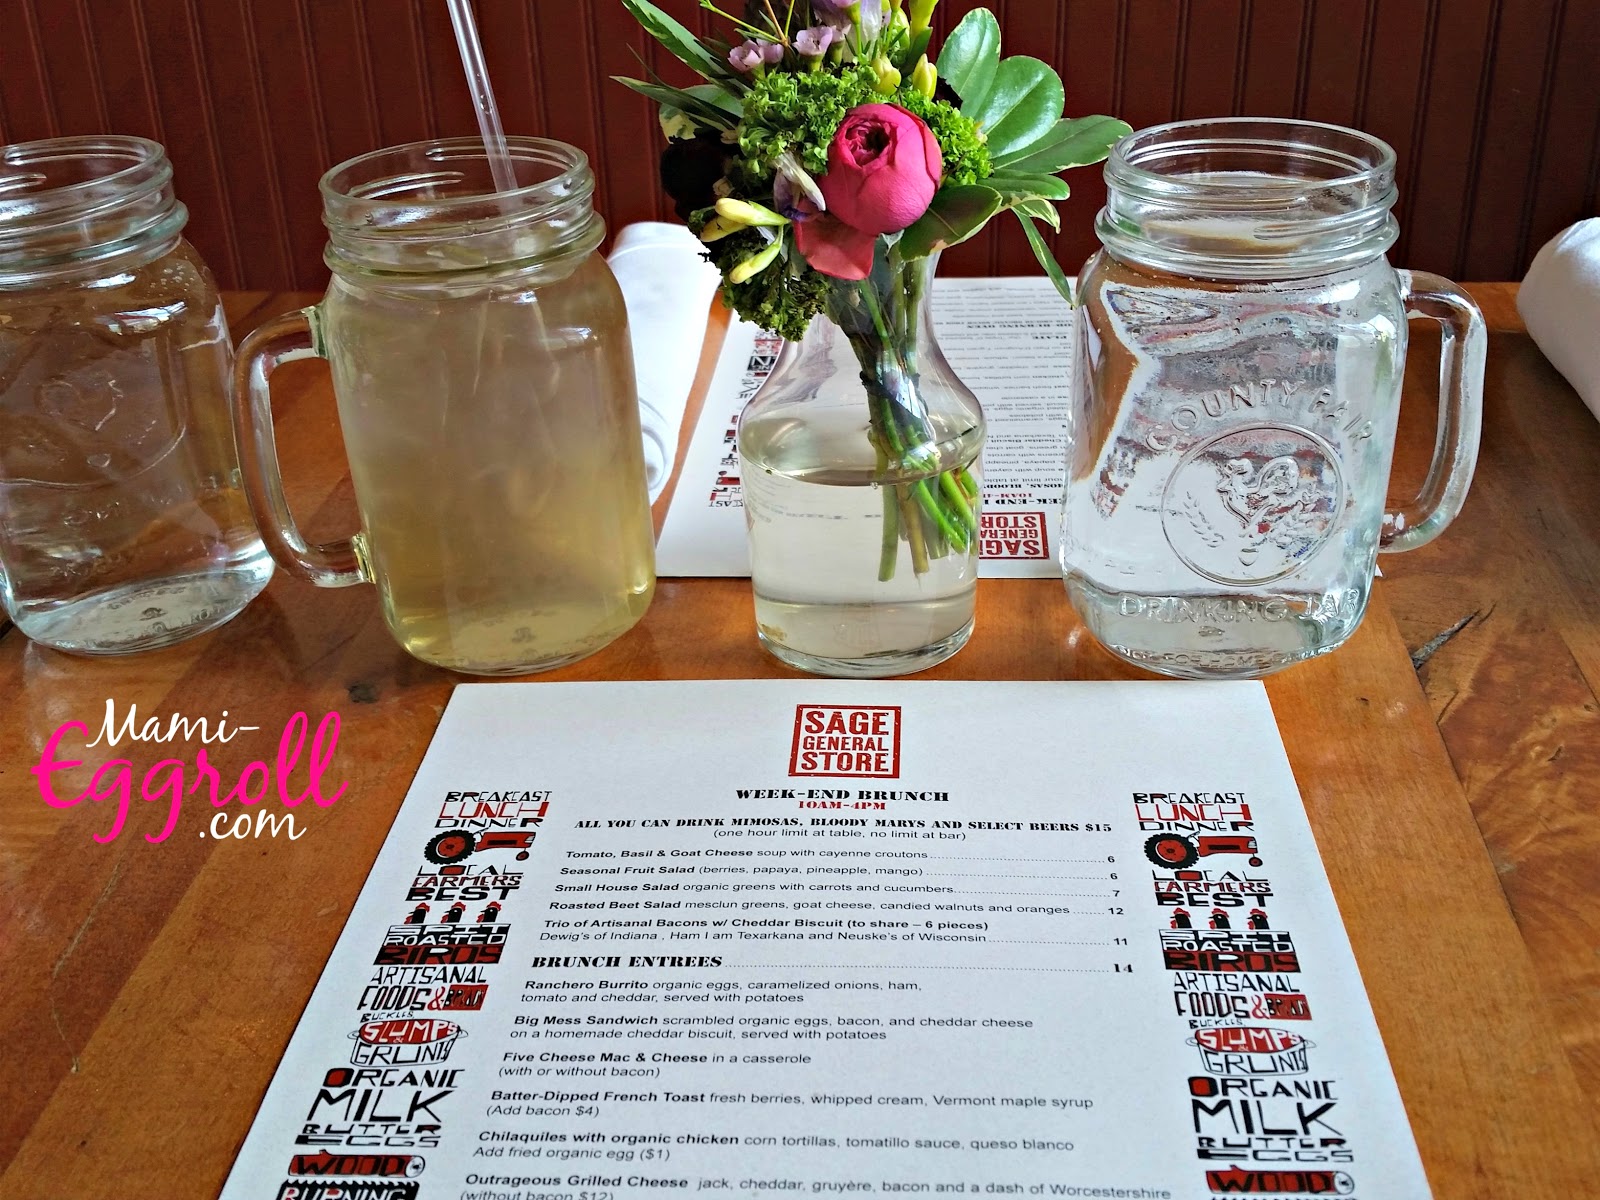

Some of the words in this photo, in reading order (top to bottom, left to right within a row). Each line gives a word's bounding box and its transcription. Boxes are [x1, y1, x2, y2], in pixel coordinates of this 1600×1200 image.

[1145, 378, 1305, 451] COUNTY
[981, 516, 1037, 528] STOR
[980, 529, 1038, 538] GENERA
[804, 710, 890, 736] SAGE
[802, 736, 889, 752] GENERAL
[800, 752, 889, 772] STORE
[737, 789, 849, 799] WEEK-END
[858, 790, 948, 801] BRUNCH
[438, 802, 549, 818] LUNCH
[799, 801, 885, 810] 10AM-4PM
[1135, 803, 1251, 821] LUNCH
[434, 818, 544, 829] DINNER
[574, 820, 601, 828] ALL
[607, 819, 636, 827] YOU
[641, 819, 670, 827] CAN
[875, 820, 925, 828] MARYS
[968, 821, 1023, 830] SELECT
[1029, 823, 1079, 831] BEERS
[1085, 823, 1111, 831] $15
[1139, 820, 1255, 832] DINNER
[713, 829, 743, 838] (one
[781, 828, 807, 836] limit
[829, 829, 864, 837] table,
[891, 830, 917, 838] limit
[939, 832, 965, 841] bar)
[1107, 855, 1115, 863] 6
[699, 866, 748, 874] (berries,
[806, 866, 870, 875] pineapple,
[875, 868, 922, 876] mango)
[1110, 872, 1118, 880] 6
[405, 886, 519, 901] BEST
[1155, 892, 1274, 908] BEST
[532, 956, 620, 967] BRUNCH
[629, 956, 722, 967] ENTREES
[1113, 962, 1133, 973] 14
[370, 966, 487, 984] ARTISANAL
[1174, 972, 1300, 992] ARTISANAL
[525, 980, 594, 989] Ranchero
[598, 980, 648, 989] Burrito
[653, 981, 702, 991] organic
[706, 982, 741, 991] eggs,
[748, 981, 829, 989] caramelized
[834, 981, 882, 990] onions,
[888, 981, 921, 990] ham,
[357, 985, 432, 1011] FOODS
[514, 1015, 538, 1027] Big
[543, 1015, 581, 1025] Mess
[587, 1015, 657, 1024] Sandwich
[663, 1016, 734, 1025] scrambled
[739, 1016, 789, 1027] organic
[794, 1018, 831, 1027] eggs,
[837, 1016, 883, 1026] bacon,
[889, 1017, 914, 1026] and
[920, 1017, 976, 1026] cheddar
[982, 1018, 1032, 1027] cheese
[545, 1029, 622, 1038] homemade
[627, 1029, 683, 1038] cheddar
[688, 1029, 735, 1039] biscuit,
[741, 1030, 788, 1038] served
[793, 1030, 821, 1039] with
[826, 1030, 886, 1040] potatoes
[503, 1052, 534, 1062] Five
[539, 1052, 595, 1062] Cheese
[600, 1052, 630, 1062] Mac
[635, 1052, 645, 1062] &
[651, 1052, 707, 1062] Cheese
[712, 1053, 724, 1062] in
[729, 1055, 737, 1063] a
[743, 1054, 811, 1063] casserole
[323, 1067, 465, 1088] ORGANIC
[499, 1066, 532, 1077] (with
[537, 1068, 552, 1076] or
[556, 1066, 606, 1076] without
[611, 1067, 660, 1078] bacon)
[1188, 1076, 1338, 1100] ORGANIC
[306, 1089, 454, 1122] MILK
[491, 1090, 598, 1103] Batter-Dipped
[604, 1091, 657, 1101] French
[664, 1092, 705, 1102] Toast
[710, 1093, 745, 1103] fresh
[751, 1094, 804, 1104] berries,
[811, 1094, 872, 1106] whipped
[877, 1097, 927, 1106] cream,
[933, 1095, 995, 1105] Vermont
[1001, 1097, 1046, 1108] maple
[1052, 1099, 1093, 1109] syrup
[486, 1105, 521, 1116] (Add
[526, 1106, 570, 1115] bacon
[575, 1105, 599, 1117] $4)
[1192, 1100, 1344, 1136] MILK
[473, 1146, 504, 1157] Add
[508, 1146, 541, 1157] fried
[546, 1149, 601, 1160] organic
[606, 1150, 634, 1161] egg
[640, 1148, 670, 1161] ($1)
